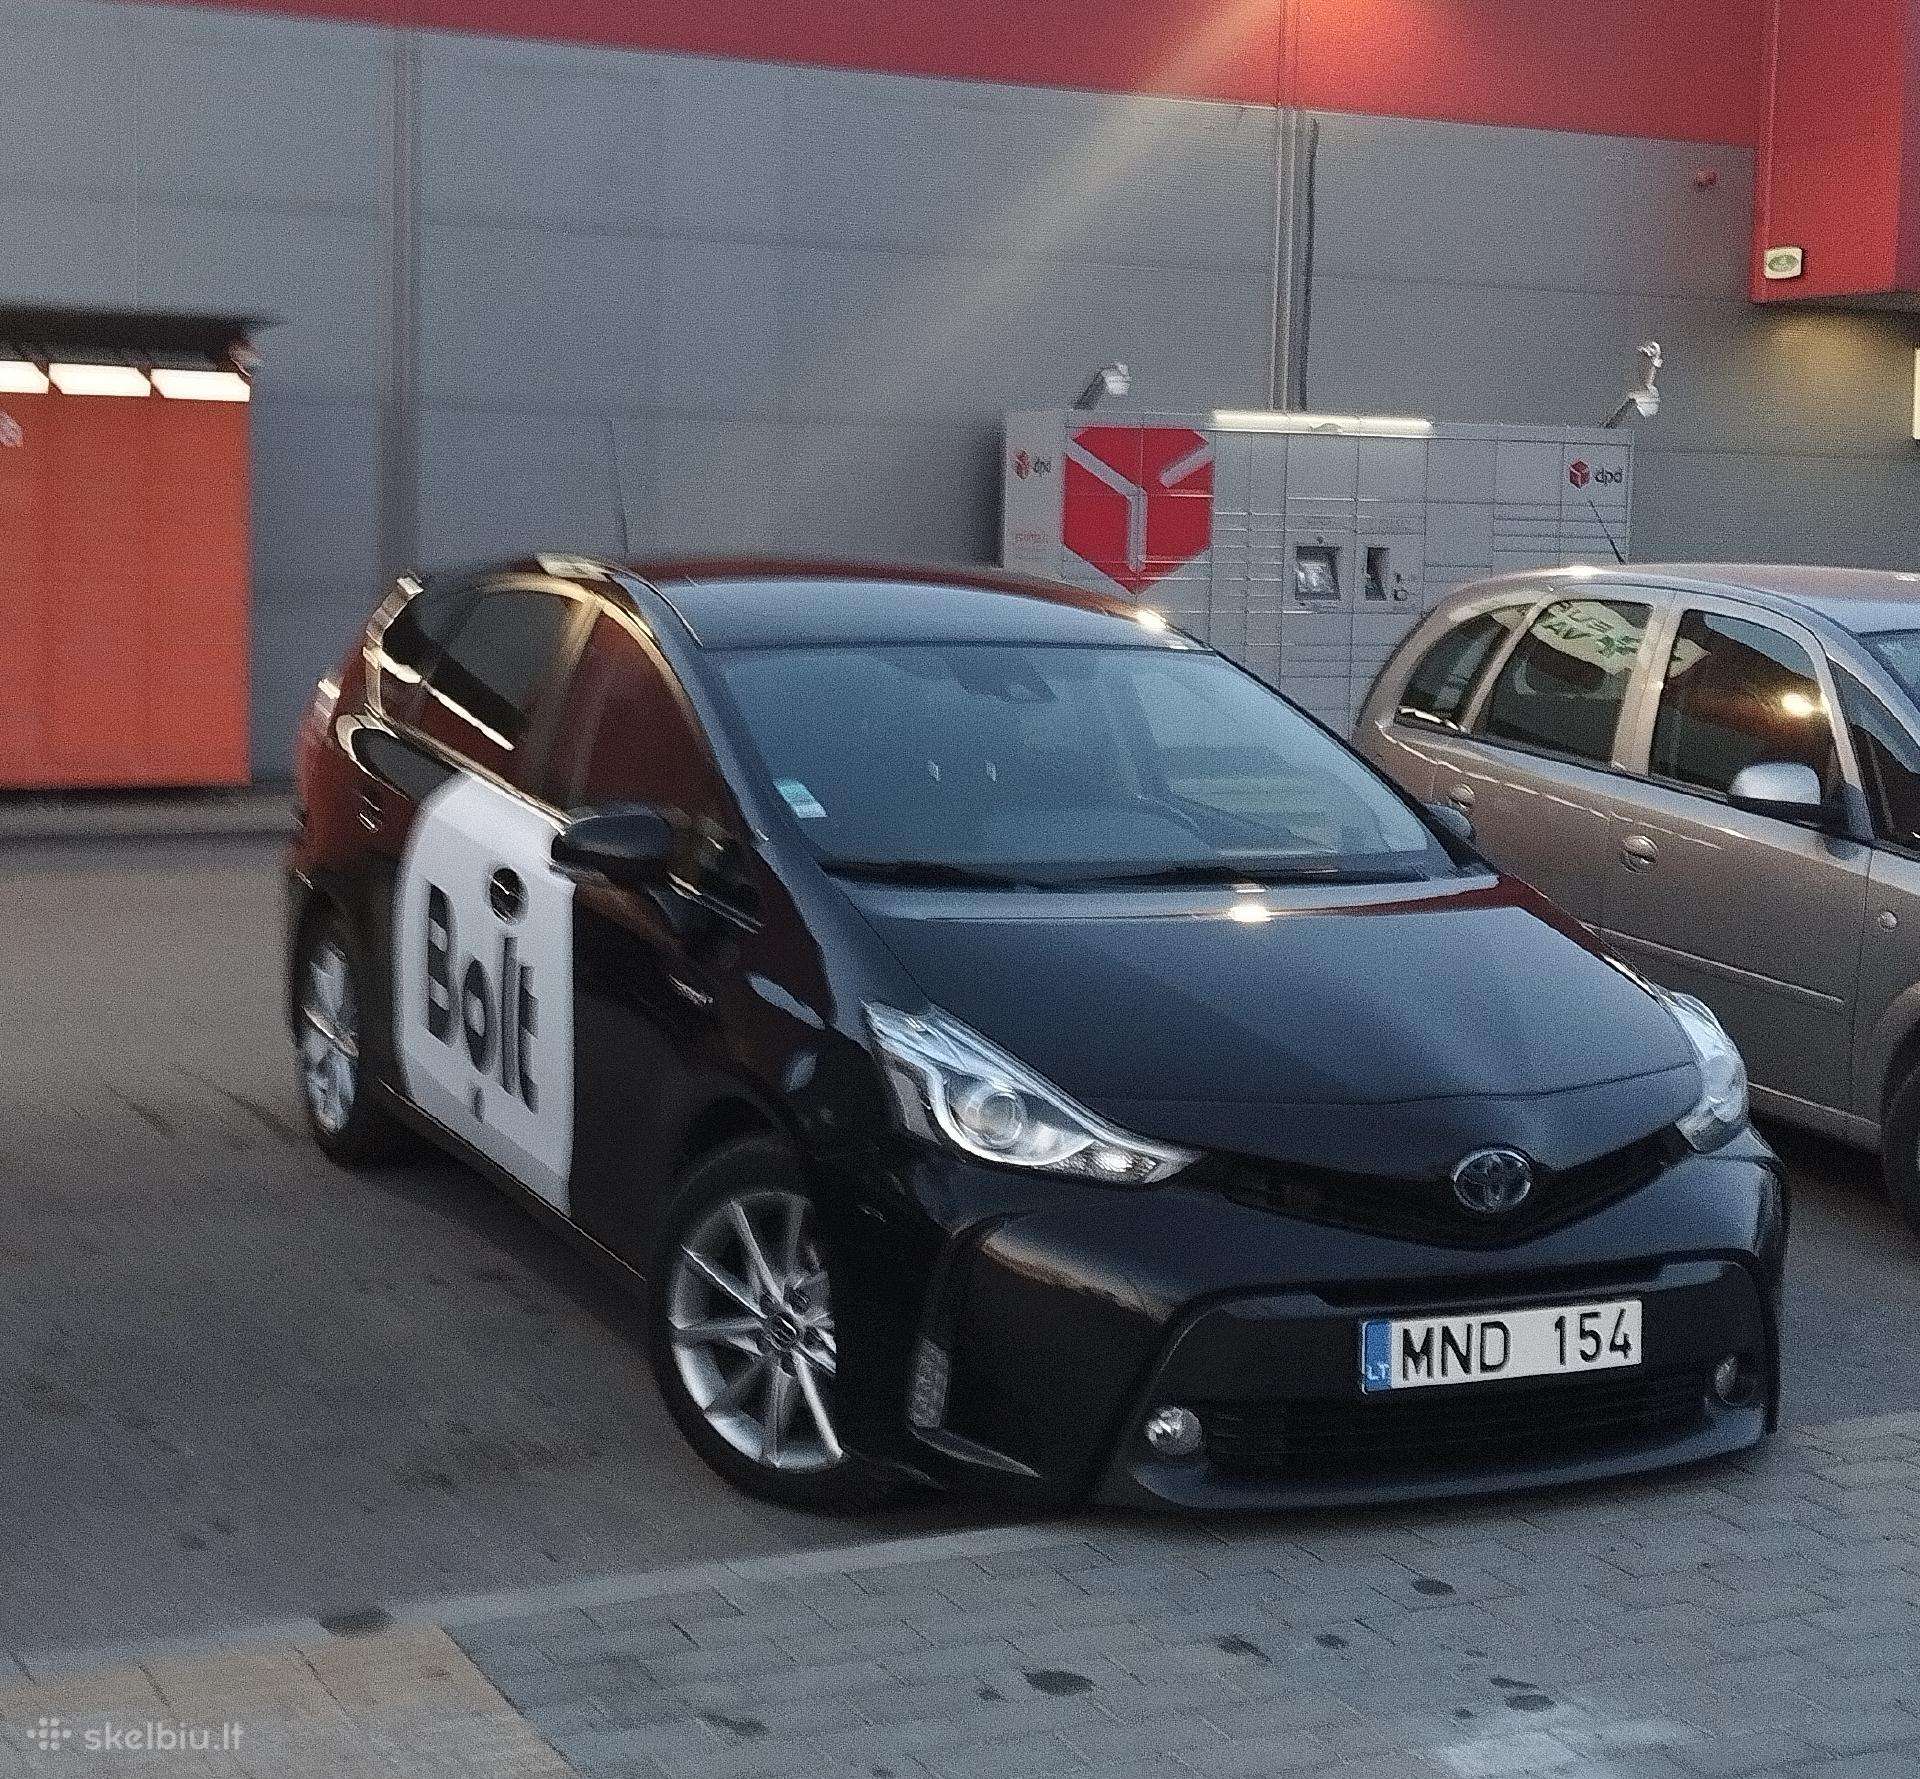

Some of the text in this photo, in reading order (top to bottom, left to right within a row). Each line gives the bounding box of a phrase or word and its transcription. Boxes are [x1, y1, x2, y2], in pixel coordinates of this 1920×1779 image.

[1594, 466, 1623, 487] dpd
[426, 880, 541, 1116] Bolt
[1366, 1308, 1633, 1382] LT MND 154
